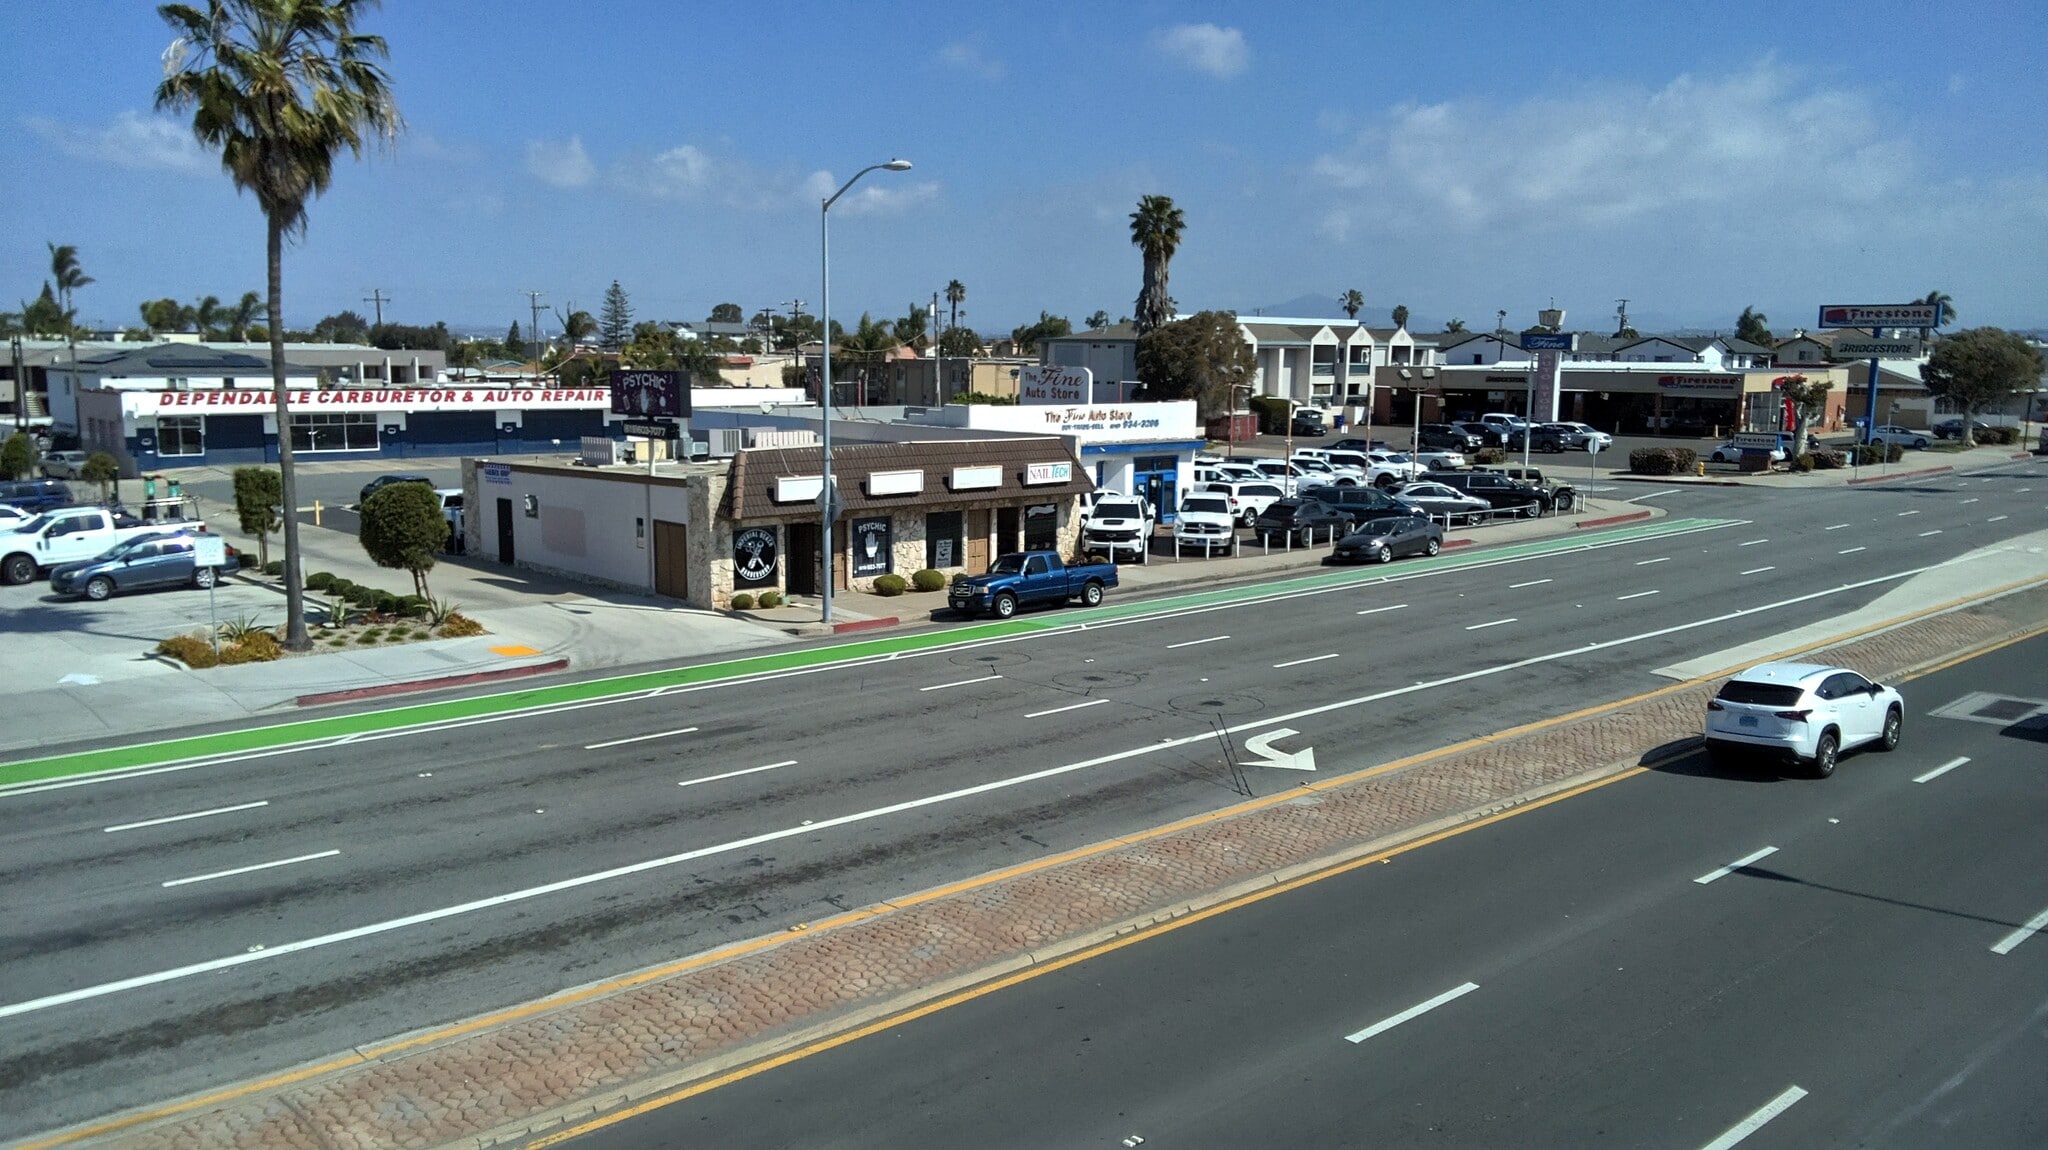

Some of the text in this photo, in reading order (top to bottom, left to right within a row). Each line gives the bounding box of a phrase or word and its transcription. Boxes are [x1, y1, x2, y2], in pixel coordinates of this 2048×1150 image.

[1849, 308, 1932, 319] Firestone
[1839, 343, 1914, 353] BRIDGESTONE
[623, 374, 666, 391] PSYCHIC
[1025, 367, 1084, 386] The Fine
[1675, 376, 1736, 385] Firestone
[317, 389, 456, 404] CARBURETOR
[461, 390, 474, 403] &
[483, 389, 534, 402] AUTO
[541, 389, 605, 402] REPAIR
[1025, 387, 1080, 400] Auto Store
[1045, 411, 1061, 423] The
[1110, 409, 1133, 421] Store
[1030, 464, 1068, 480] NAIL TECH
[858, 523, 887, 533] PSYCHIC
